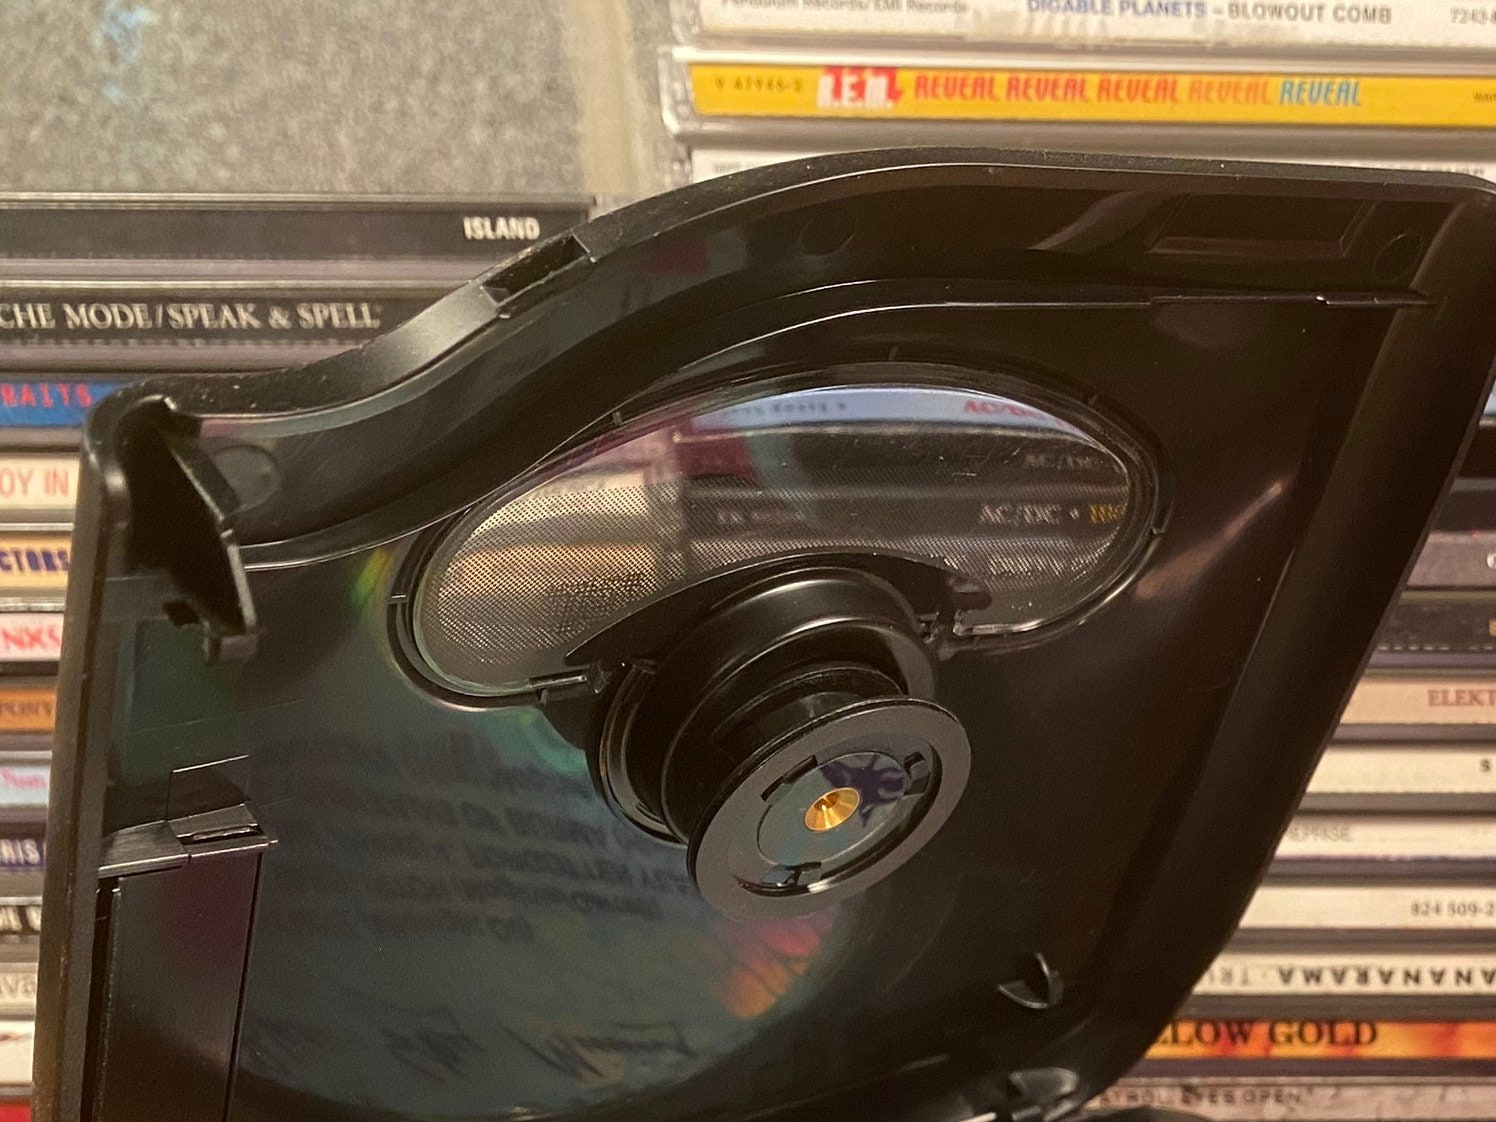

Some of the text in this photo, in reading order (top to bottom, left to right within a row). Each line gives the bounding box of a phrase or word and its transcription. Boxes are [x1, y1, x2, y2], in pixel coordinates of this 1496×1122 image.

[1121, 1, 1207, 19] PLANETS
[1227, 2, 1324, 21] BLOWOUT
[1332, 4, 1392, 24] COMB
[914, 74, 997, 102] REVEAL
[1004, 75, 1089, 103] REVEAL
[1096, 76, 1180, 104] REVEAL
[1187, 78, 1271, 105] REVEAL
[1278, 79, 1362, 106] REVEAL
[463, 216, 540, 240] ISLAND
[269, 305, 291, 328] &
[296, 302, 381, 329] SPELL
[43, 469, 69, 498] IN
[1267, 1020, 1379, 1047] GOLD
